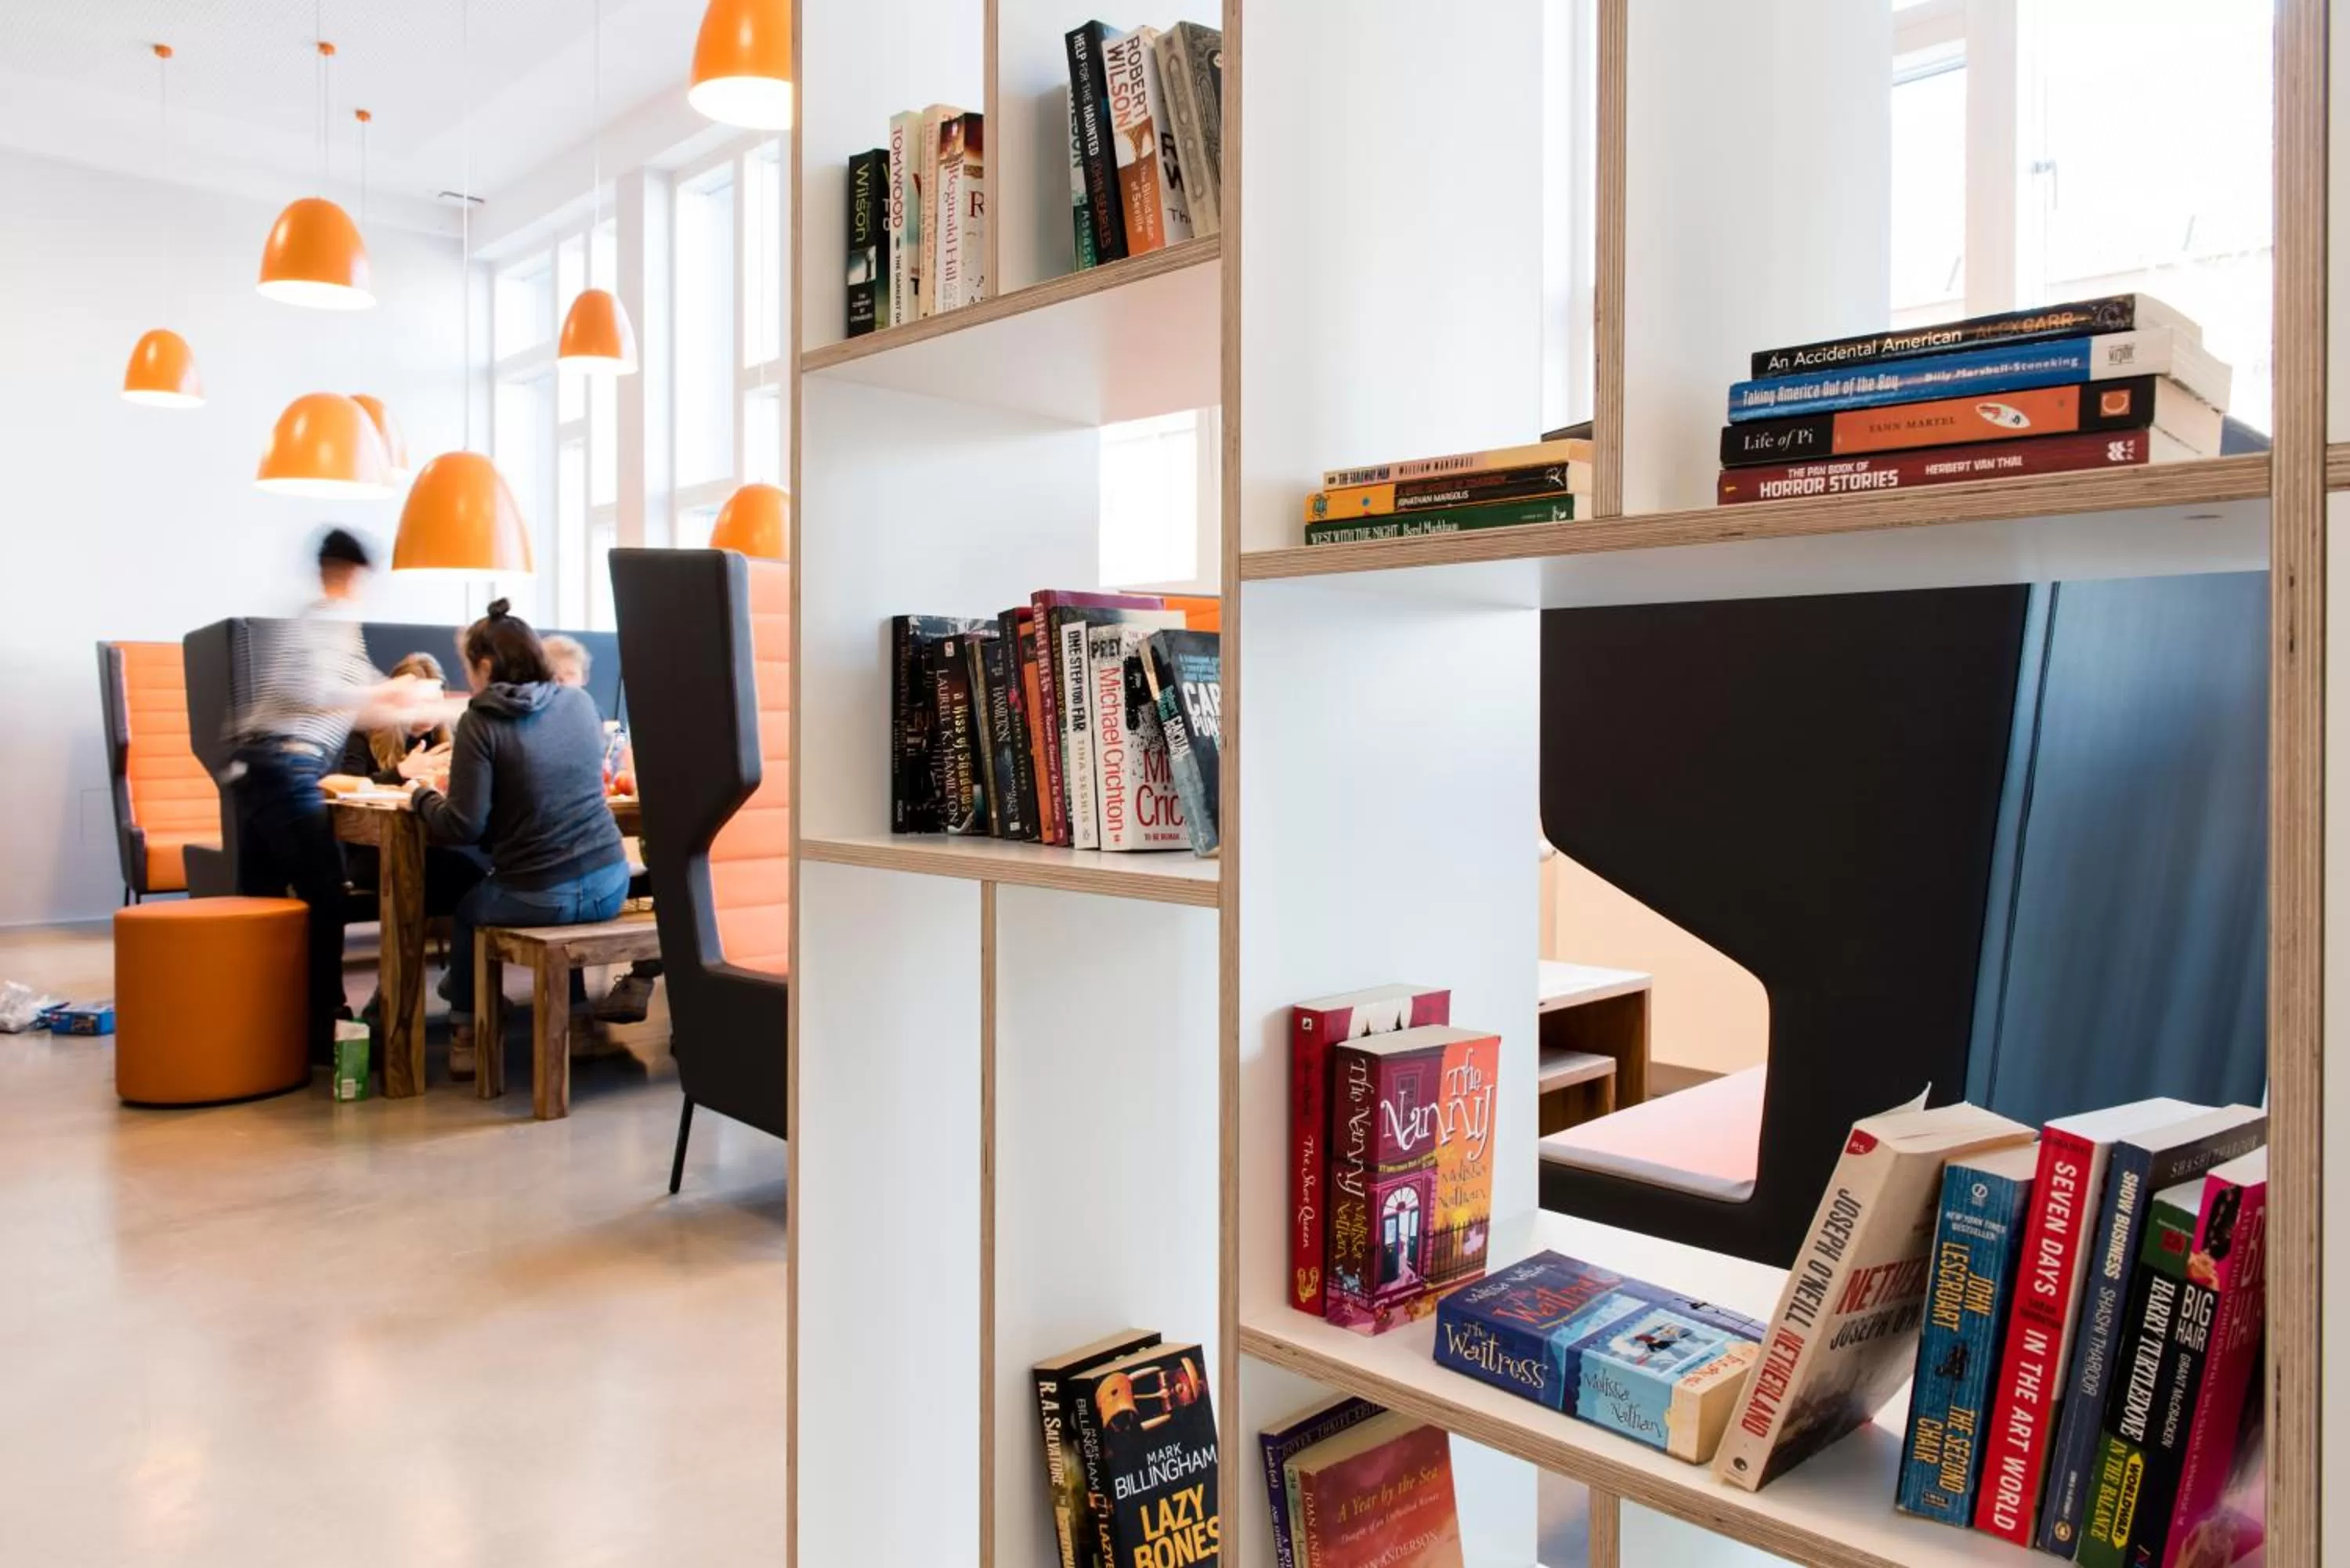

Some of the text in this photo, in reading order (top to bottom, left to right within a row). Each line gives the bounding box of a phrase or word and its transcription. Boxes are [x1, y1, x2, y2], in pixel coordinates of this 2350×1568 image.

[1073, 34, 1086, 61] HELP
[1082, 84, 1094, 103] THE
[1108, 44, 1132, 132] WILSON
[1126, 34, 1148, 117] ROBERT
[1083, 103, 1100, 156] HAUNTED
[892, 125, 903, 229] TOM WOOD
[855, 162, 870, 242] Wilson
[945, 247, 957, 281] Hill
[1768, 356, 1789, 370] An
[1793, 340, 1878, 367] Accidental
[1881, 330, 1962, 353] American
[2022, 311, 2076, 331] CARR
[1743, 387, 1776, 407] Taking
[1777, 383, 1821, 402] America
[1822, 381, 1840, 398] Out
[1842, 378, 1855, 397] of
[1857, 375, 1875, 394] the
[1743, 415, 1956, 451] Life of Pi YANN MARTEL
[1760, 469, 1900, 498] HORROR STORIES
[1788, 461, 1870, 479] THE PAN BOOK OF
[1925, 455, 2023, 475] HERBERT VAN THAL
[1397, 490, 1469, 508] JONATHAN MARGOLIS
[1372, 524, 1398, 540] NIGHT
[1067, 630, 1082, 656] ONE
[1090, 637, 1122, 659] PREY
[1069, 657, 1083, 685] STEP
[1072, 686, 1083, 703] TOO
[1071, 706, 1086, 732] FAR
[1098, 667, 1126, 832] Michael Crichton
[943, 749, 960, 823] HAMILTON
[1448, 1046, 1482, 1098] The
[1336, 1058, 1373, 1198] The Nanny
[1380, 1083, 1494, 1162] Nanny
[1301, 1136, 1314, 1166] The
[1300, 1167, 1317, 1203] Shoe
[2044, 1160, 2078, 1237] SEVEN
[1297, 1204, 1316, 1249] Queen
[1932, 1241, 1971, 1331] LESCROART
[2034, 1237, 2065, 1298] DAYS
[2081, 1170, 2138, 1396] SHOW BUSINESS SHASHI THAROOR
[1741, 1188, 1862, 1440] JOSEPH O'NEILL NETHERLAND
[1965, 1270, 1996, 1316] JOHN
[2144, 1275, 2176, 1341] HARRY
[2181, 1282, 2214, 1328] BIG
[1444, 1323, 1549, 1389] Waitress
[2023, 1328, 2048, 1355] IN
[2175, 1316, 2208, 1353] HAIR
[1585, 1367, 1630, 1401] Melissa
[2014, 1355, 2044, 1406] THE
[2120, 1335, 2166, 1443] TURTLEDOVE
[2176, 1353, 2192, 1390] GRANT
[1610, 1400, 1663, 1439] Nathan
[1913, 1416, 1944, 1464] CHAIR
[2005, 1406, 2036, 1461] ART
[1043, 1416, 1065, 1487] SALVATORE
[1076, 1397, 1100, 1491] BILLINGHAM
[1146, 1443, 1183, 1465] MARK
[1938, 1407, 1975, 1495] THE SECOND
[1115, 1445, 1218, 1500] BILLINGHAM
[2090, 1437, 2128, 1542] IN THE BALANCE
[1141, 1483, 1205, 1542] LAZY
[1303, 1491, 1318, 1528] JOAN
[1337, 1503, 1349, 1524] A
[1353, 1492, 1378, 1517] Year
[1381, 1482, 1394, 1508] by
[1993, 1460, 2026, 1534] WORLD
